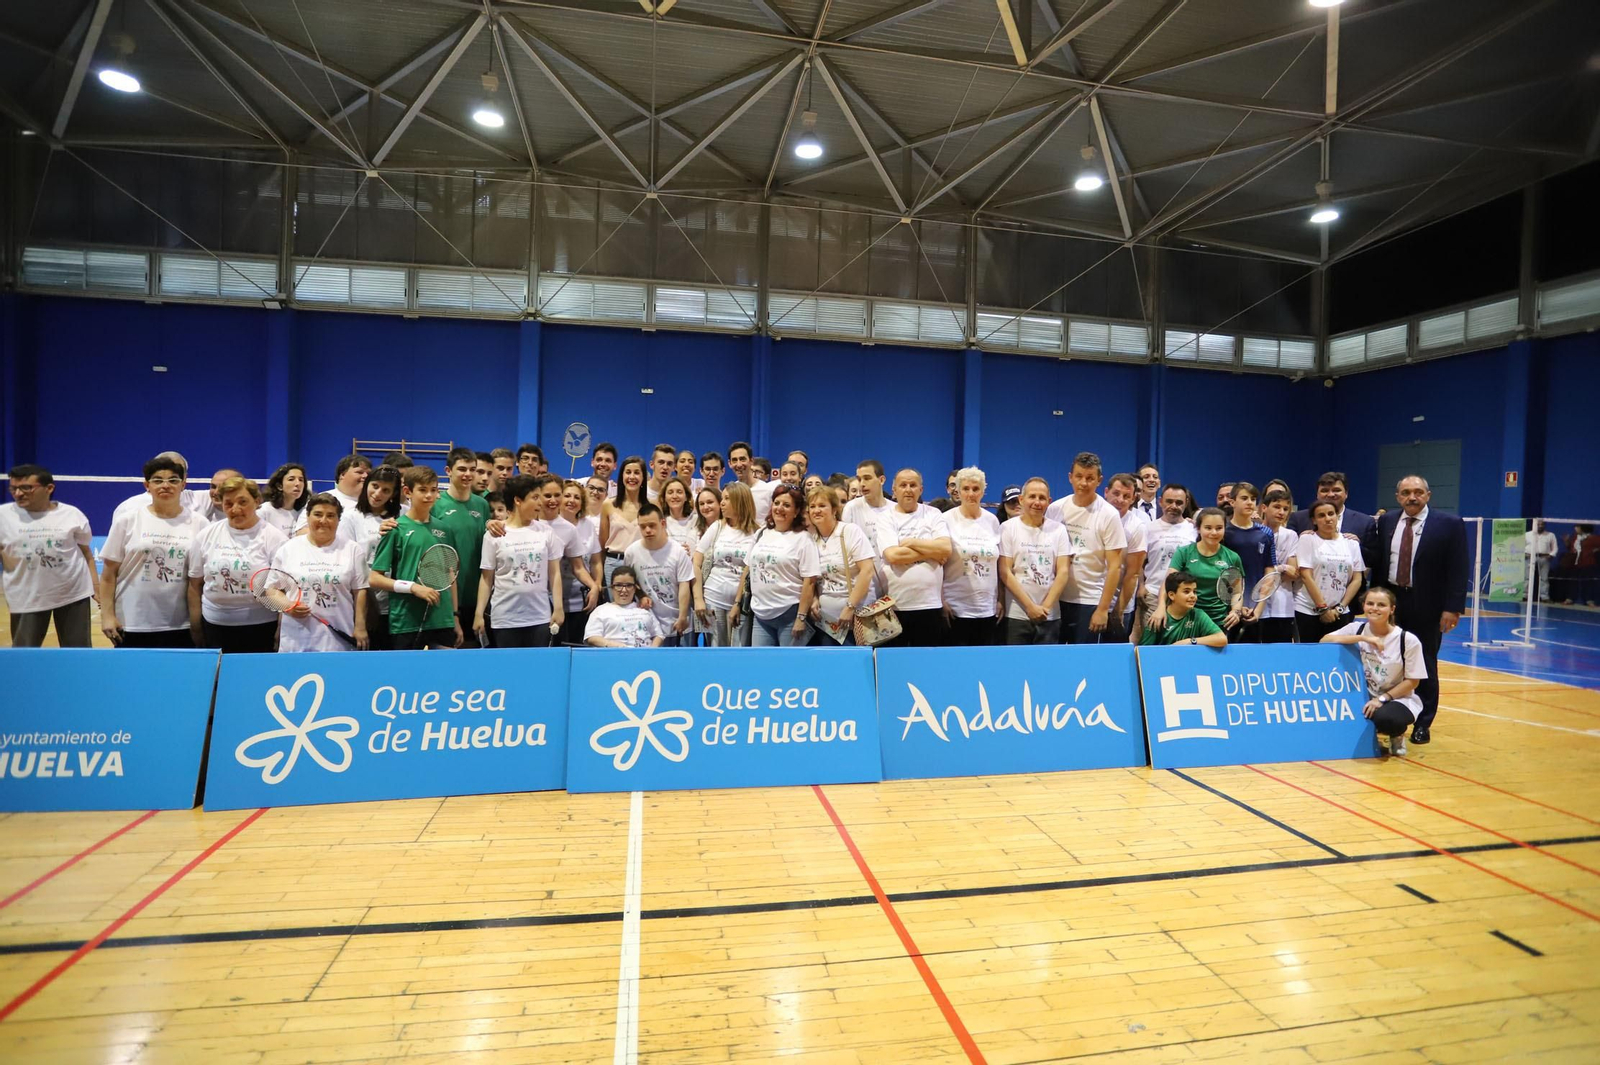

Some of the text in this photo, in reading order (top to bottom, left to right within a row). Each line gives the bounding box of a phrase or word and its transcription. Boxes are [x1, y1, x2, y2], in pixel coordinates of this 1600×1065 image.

[701, 682, 820, 715] Que sea
[1221, 667, 1362, 697] DIPUTACIÓN
[370, 685, 507, 720] Que sea
[896, 677, 1128, 743] Andalucía
[1159, 674, 1218, 729] H
[1226, 698, 1356, 726] DE HUELVA
[0, 729, 132, 749] yuntamiento de
[367, 717, 548, 754] de Huelva
[701, 713, 859, 746] de Huelva
